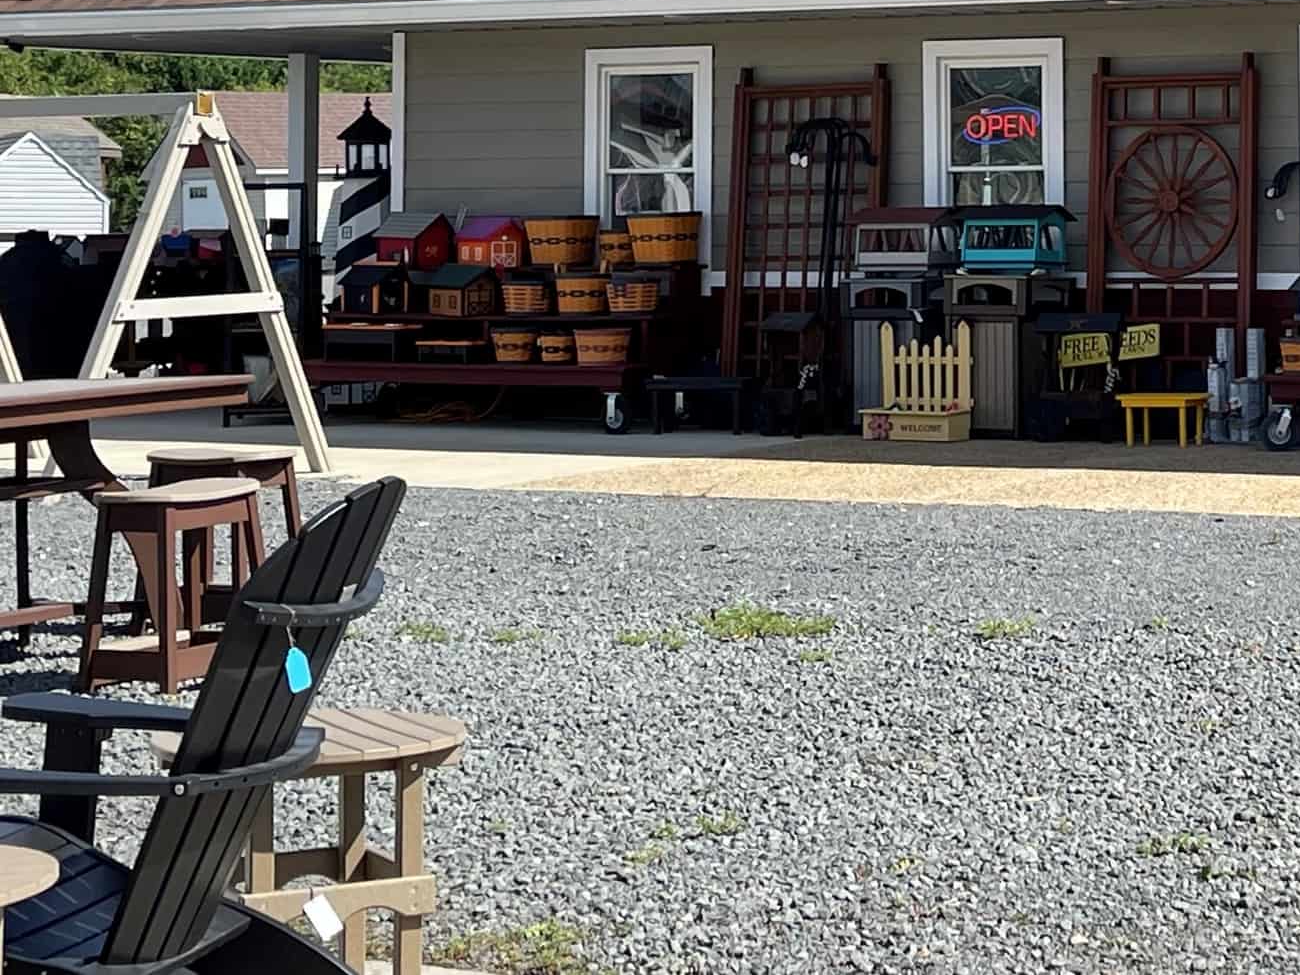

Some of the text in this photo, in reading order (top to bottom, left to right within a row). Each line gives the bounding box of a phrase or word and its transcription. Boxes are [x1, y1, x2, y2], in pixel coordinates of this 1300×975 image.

[966, 114, 1037, 138] OPEN
[1063, 336, 1099, 355] FREE
[900, 424, 942, 433] WELCOME
